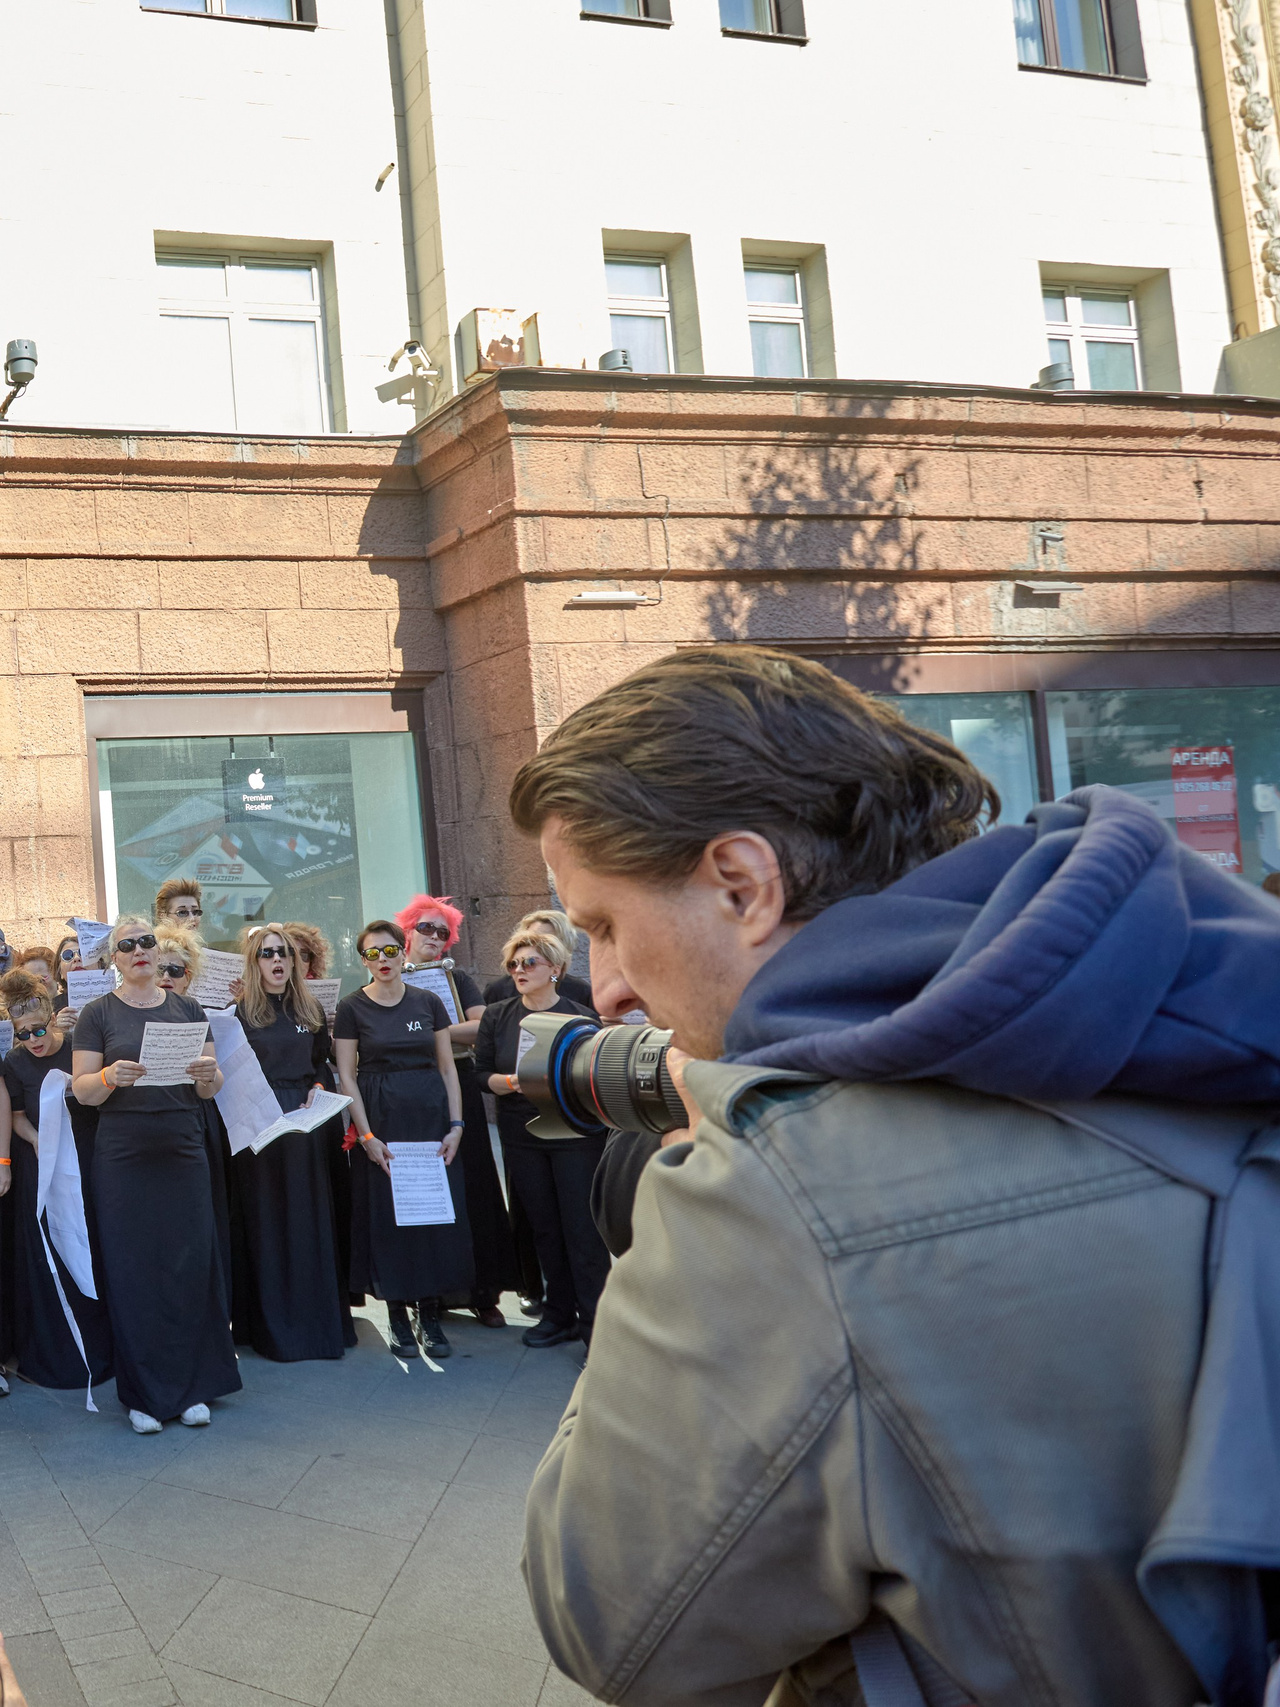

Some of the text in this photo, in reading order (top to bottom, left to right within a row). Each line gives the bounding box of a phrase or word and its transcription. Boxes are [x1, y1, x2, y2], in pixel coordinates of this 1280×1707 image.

[1172, 752, 1231, 767] АРЕНДА
[242, 794, 274, 802] Premium
[245, 803, 273, 811] Reseller
